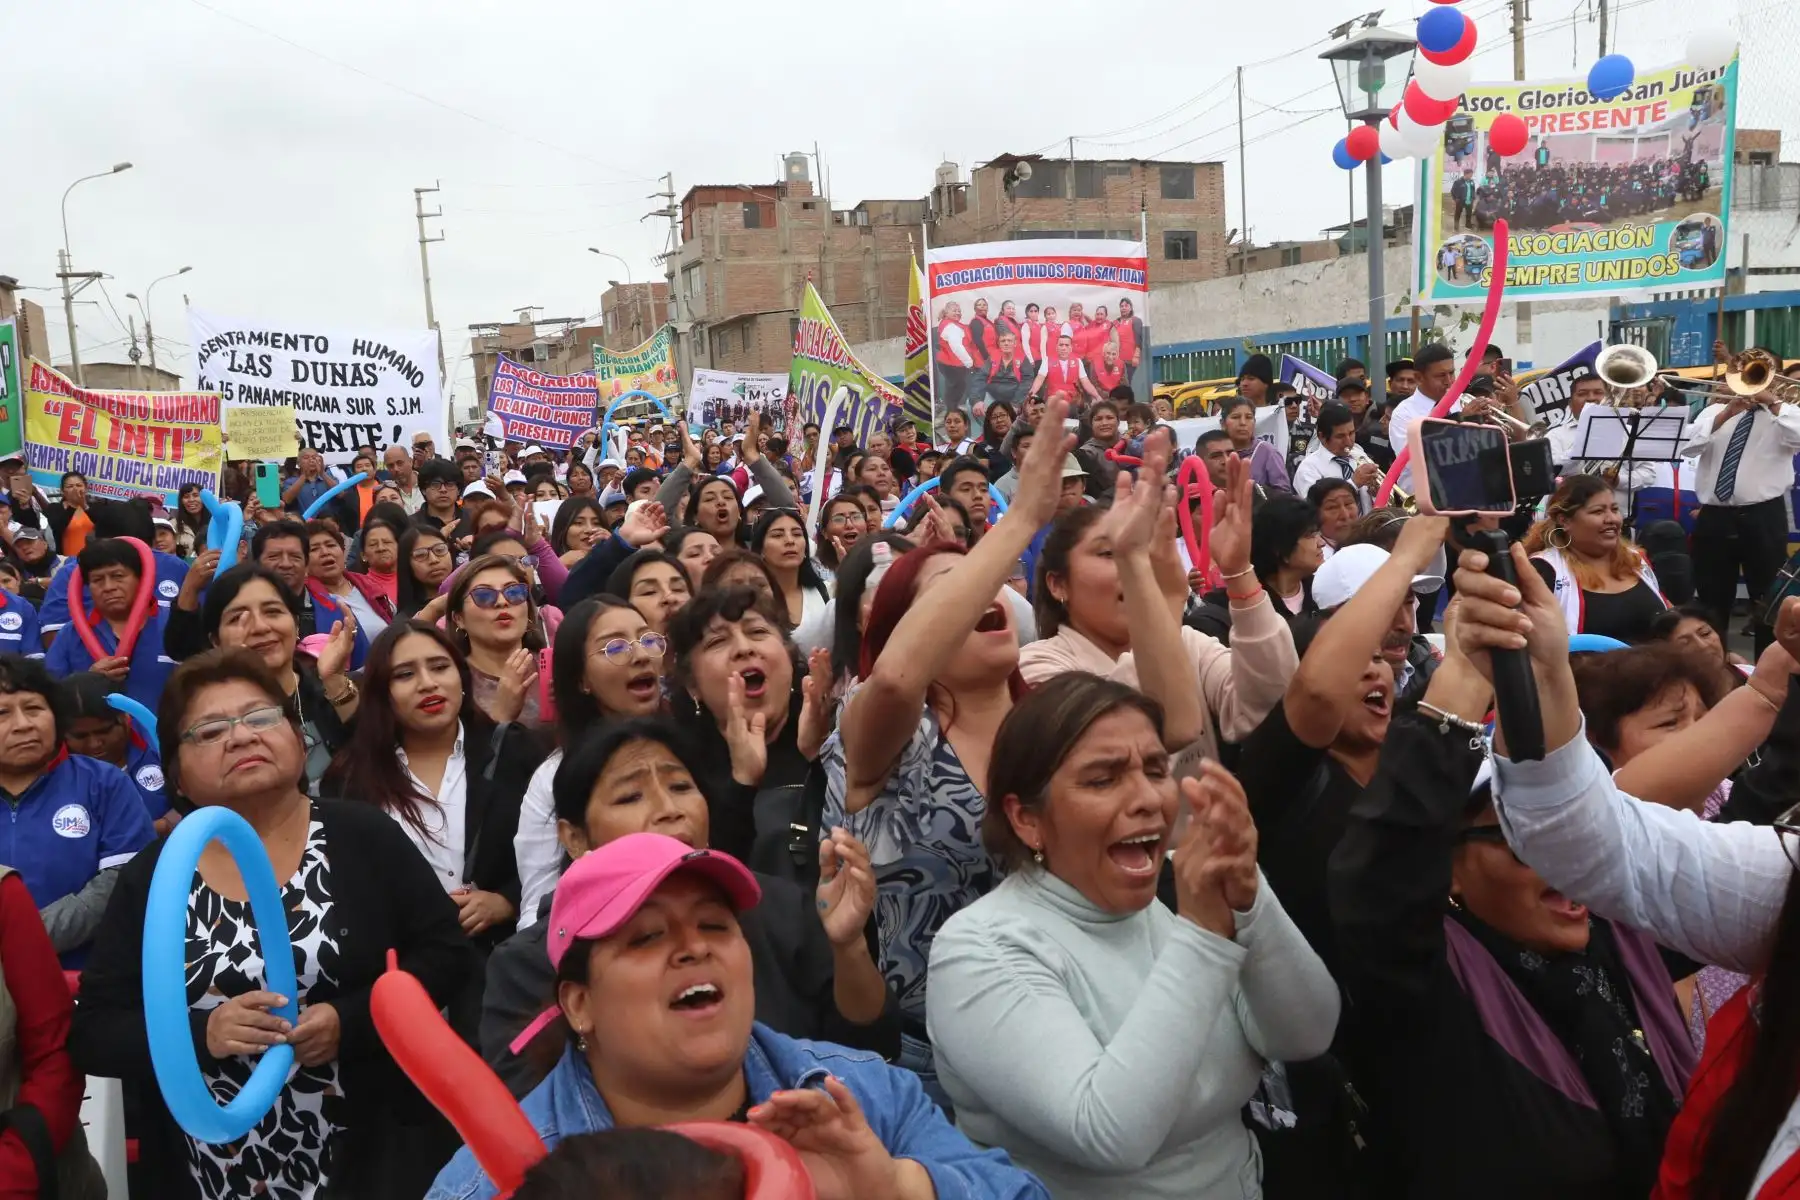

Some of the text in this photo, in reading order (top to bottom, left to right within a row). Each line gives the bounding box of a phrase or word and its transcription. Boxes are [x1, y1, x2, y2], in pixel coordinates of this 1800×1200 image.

[1457, 92, 1511, 112] Asoc.
[1523, 100, 1668, 134] PRESENTE
[1507, 224, 1655, 257] ASOCIACIÓN
[936, 263, 1013, 289] ASOCIACIÓN
[1016, 263, 1065, 279] UNIDOS
[1067, 265, 1092, 280] POR
[1119, 268, 1145, 285] JUAN
[1481, 251, 1680, 288] SEMPRE UNIDOS
[198, 330, 424, 388] ASENTAMIENTO HUMANO
[219, 380, 234, 401] 15
[346, 398, 376, 416] SUR
[387, 396, 424, 416] S.J.M.
[494, 377, 597, 408] LOS EMPRENDEDORES
[151, 394, 220, 425] HUMANO
[493, 396, 592, 427] DE ALIPIO PONCE
[508, 419, 572, 445] PRESENTE
[25, 441, 216, 494] SIEMPRE CON LA DUPLA GANADORA
[87, 482, 139, 499] AMERICAN
[54, 817, 77, 831] SJM
